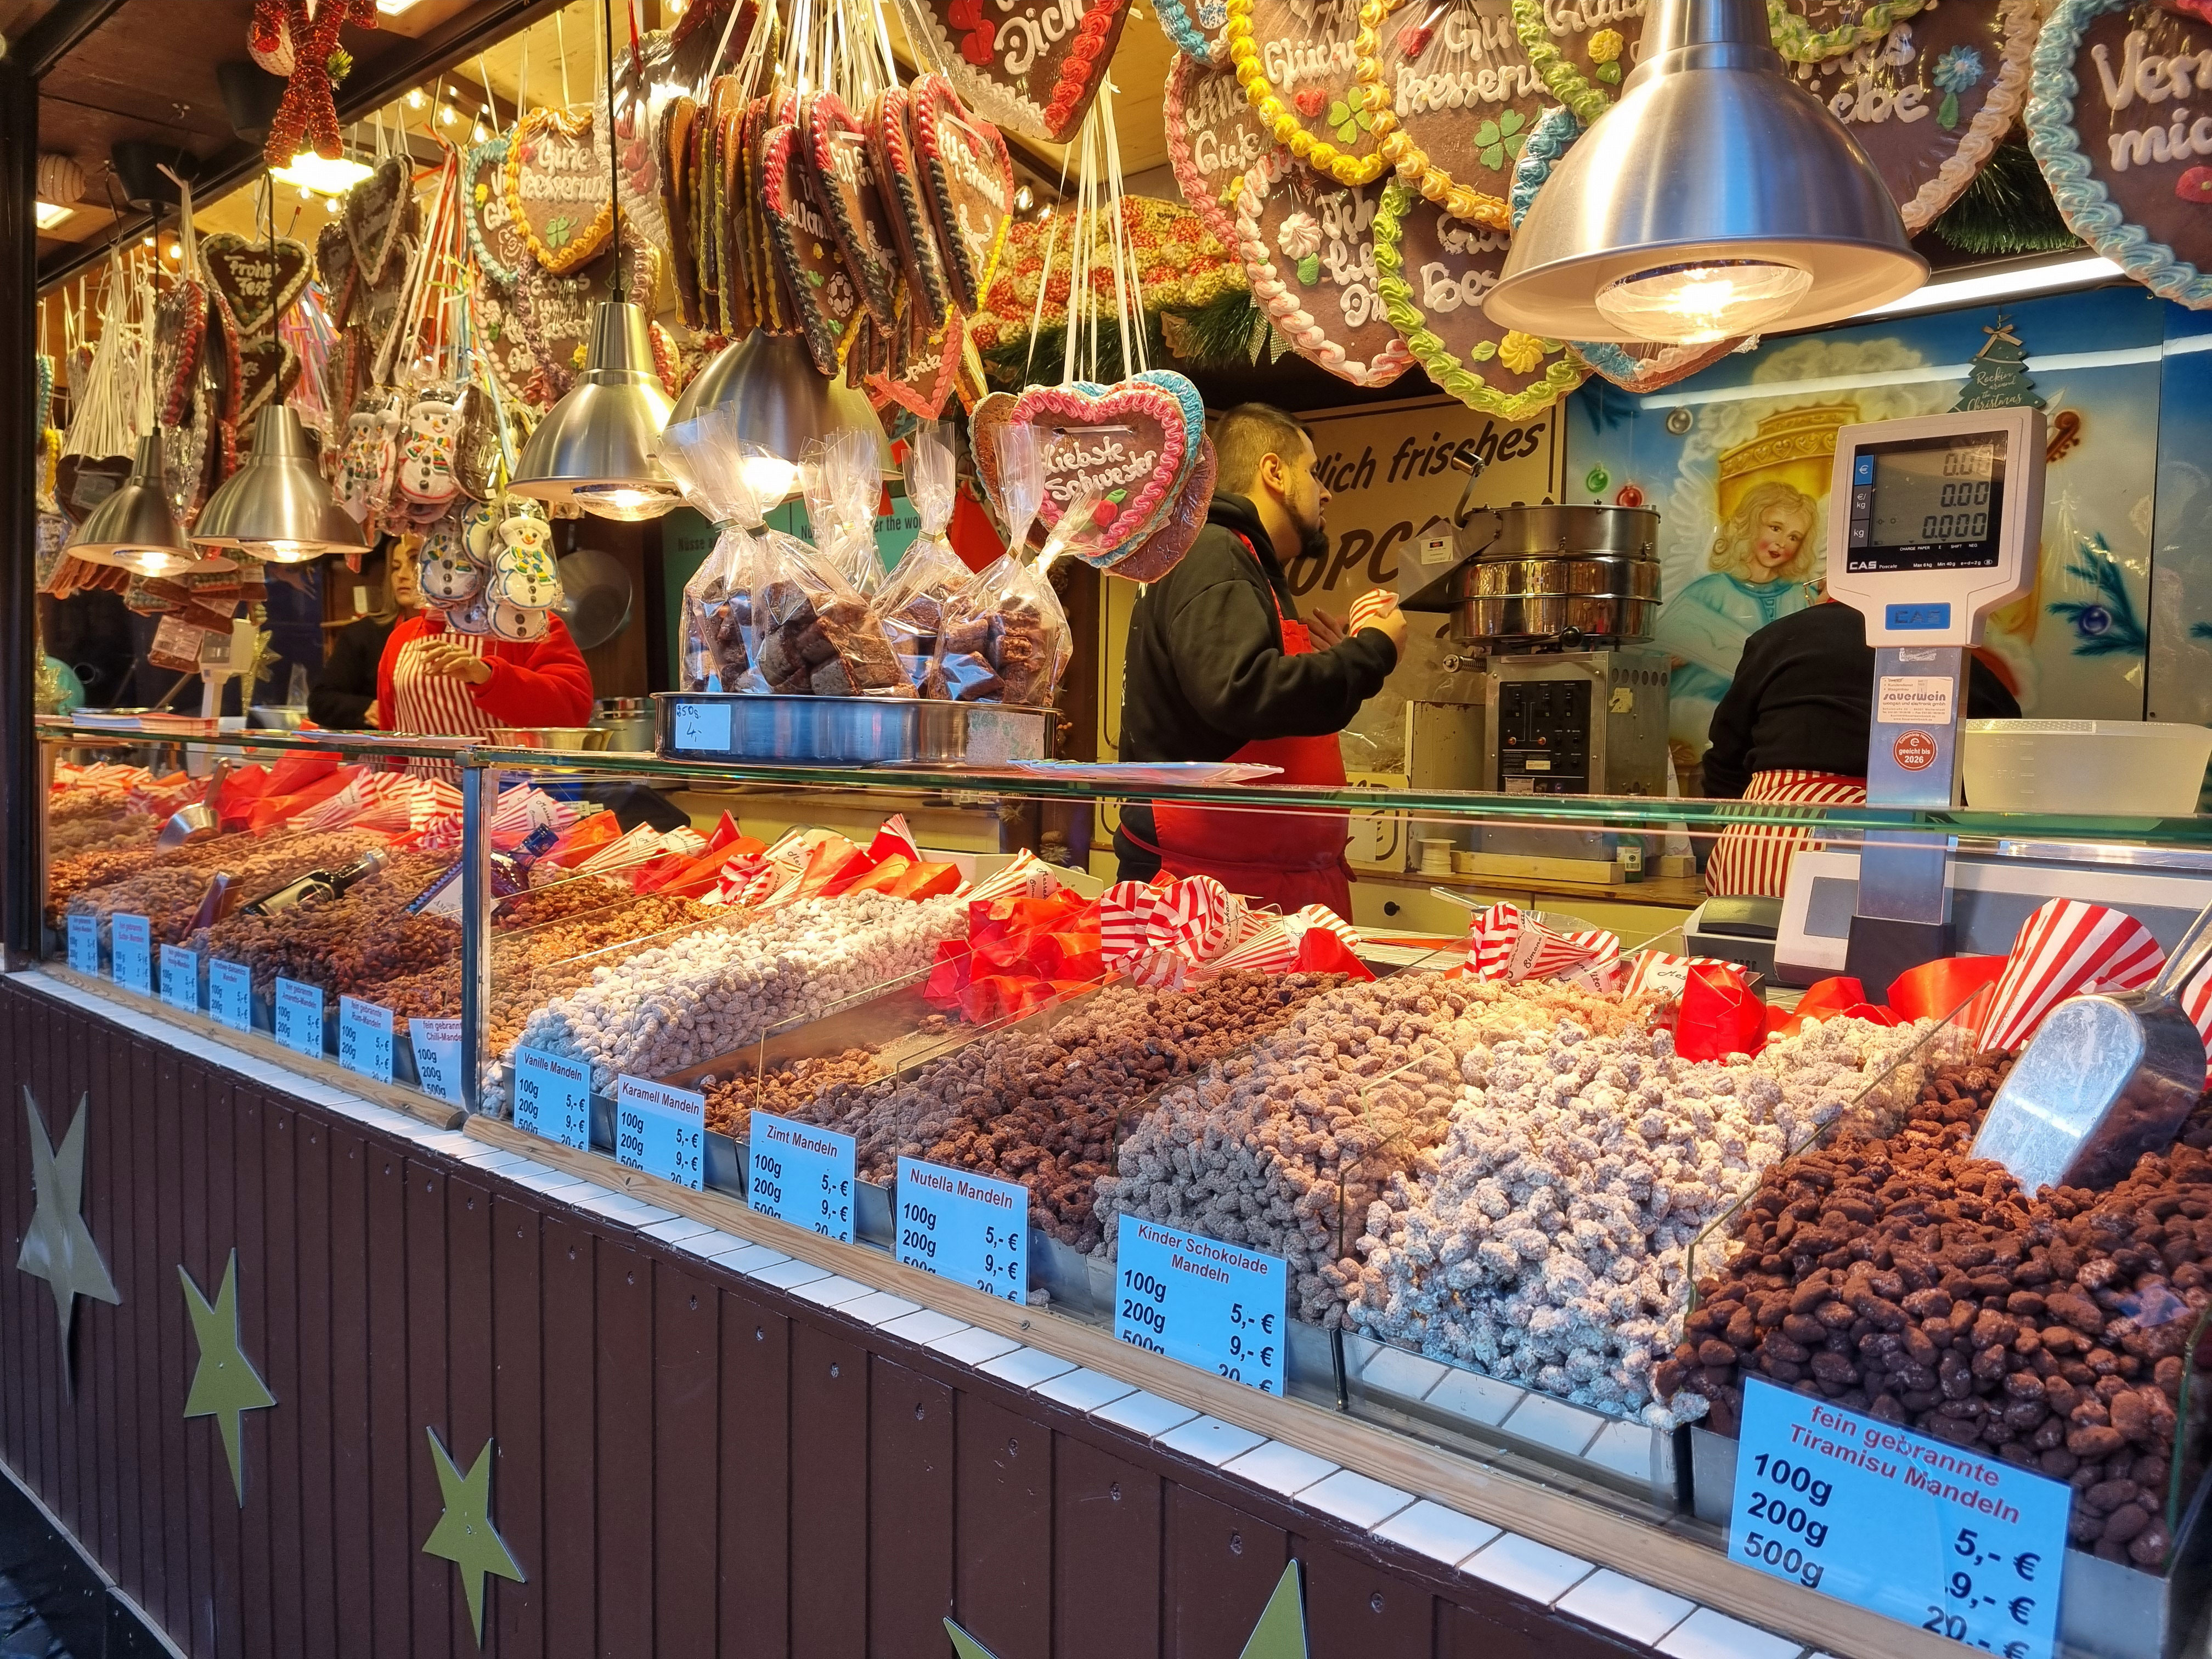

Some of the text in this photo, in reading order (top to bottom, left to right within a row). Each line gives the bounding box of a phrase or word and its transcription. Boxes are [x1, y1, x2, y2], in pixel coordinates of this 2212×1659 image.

[2108, 108, 2212, 172] mic
[1317, 445, 1376, 493] lich
[1940, 481, 1990, 508] 0.00
[1854, 512, 1988, 540] kg 0.000
[1849, 561, 1877, 570] CAS
[1883, 691, 1946, 701] sauerwein
[1904, 755, 1924, 764] 2026
[278, 1005, 291, 1022] 100g
[278, 1021, 291, 1037] 200g
[423, 1020, 462, 1031] fein gebrannt
[342, 1025, 357, 1042] 100g
[384, 1040, 390, 1052] €
[342, 1042, 357, 1060] 200g
[384, 1058, 389, 1070] €
[417, 1048, 437, 1064] 100g
[421, 1066, 442, 1082] 200g
[523, 1052, 583, 1082] Vanille Mandeln
[426, 1084, 447, 1099] 500g
[518, 1078, 586, 1113] 100g 5,- €
[622, 1081, 700, 1116] Karamell Mandeln
[518, 1098, 585, 1133] 200g 9,- €
[620, 1111, 699, 1149] 100g 5,- €
[620, 1133, 698, 1171] 200g 9,- €
[766, 1124, 838, 1158] Zimt Mandeln
[754, 1153, 849, 1197] 100g 5,- €
[909, 1167, 1013, 1209] Nutella Mandeln
[754, 1177, 849, 1222] 200g 9,- €
[902, 1202, 1019, 1251] 100g 5,- €
[902, 1228, 1019, 1280] 200g 9,- €
[1137, 1223, 1268, 1276] Kinder Schokolade
[1170, 1254, 1230, 1284] Mandeln
[1124, 1269, 1276, 1335] 100g 5,- €
[1122, 1299, 1274, 1368] 200g 9,- €
[1809, 1405, 2001, 1488] fein gebrannte
[1790, 1423, 2021, 1525] Tiramisu Mandeln
[1753, 1452, 2042, 1582] 100g 5,- €
[1743, 1531, 1825, 1590] 500g
[1747, 1491, 1829, 1549] 200g
[2007, 1596, 2037, 1627] €
